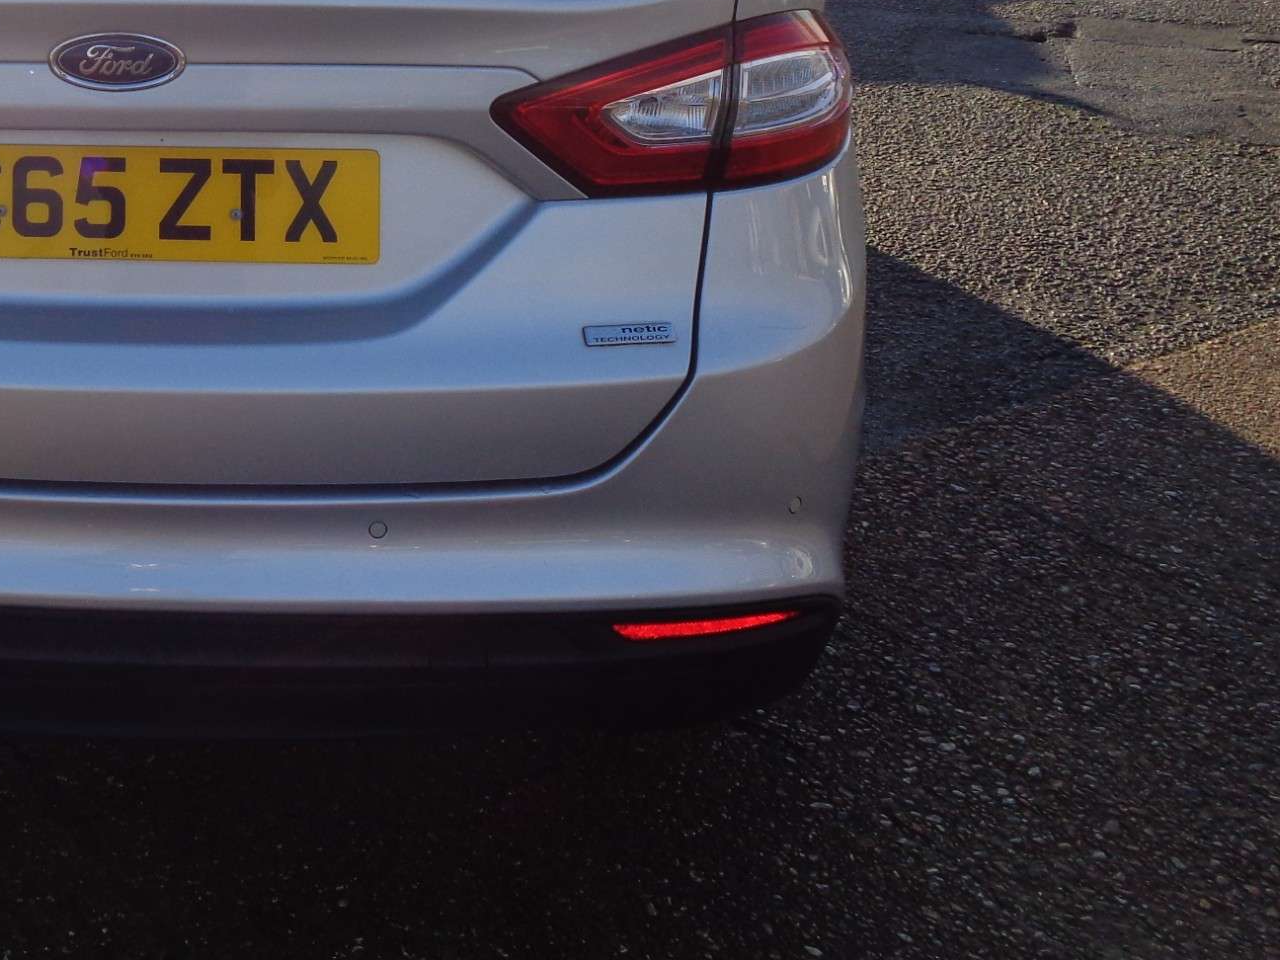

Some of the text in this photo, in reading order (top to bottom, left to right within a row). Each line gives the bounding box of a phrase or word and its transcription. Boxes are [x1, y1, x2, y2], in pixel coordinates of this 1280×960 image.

[79, 44, 154, 75] Ford
[158, 157, 338, 243] ZTX
[69, 247, 129, 258] TrustFord
[593, 334, 670, 343] TECHNOLOGY
